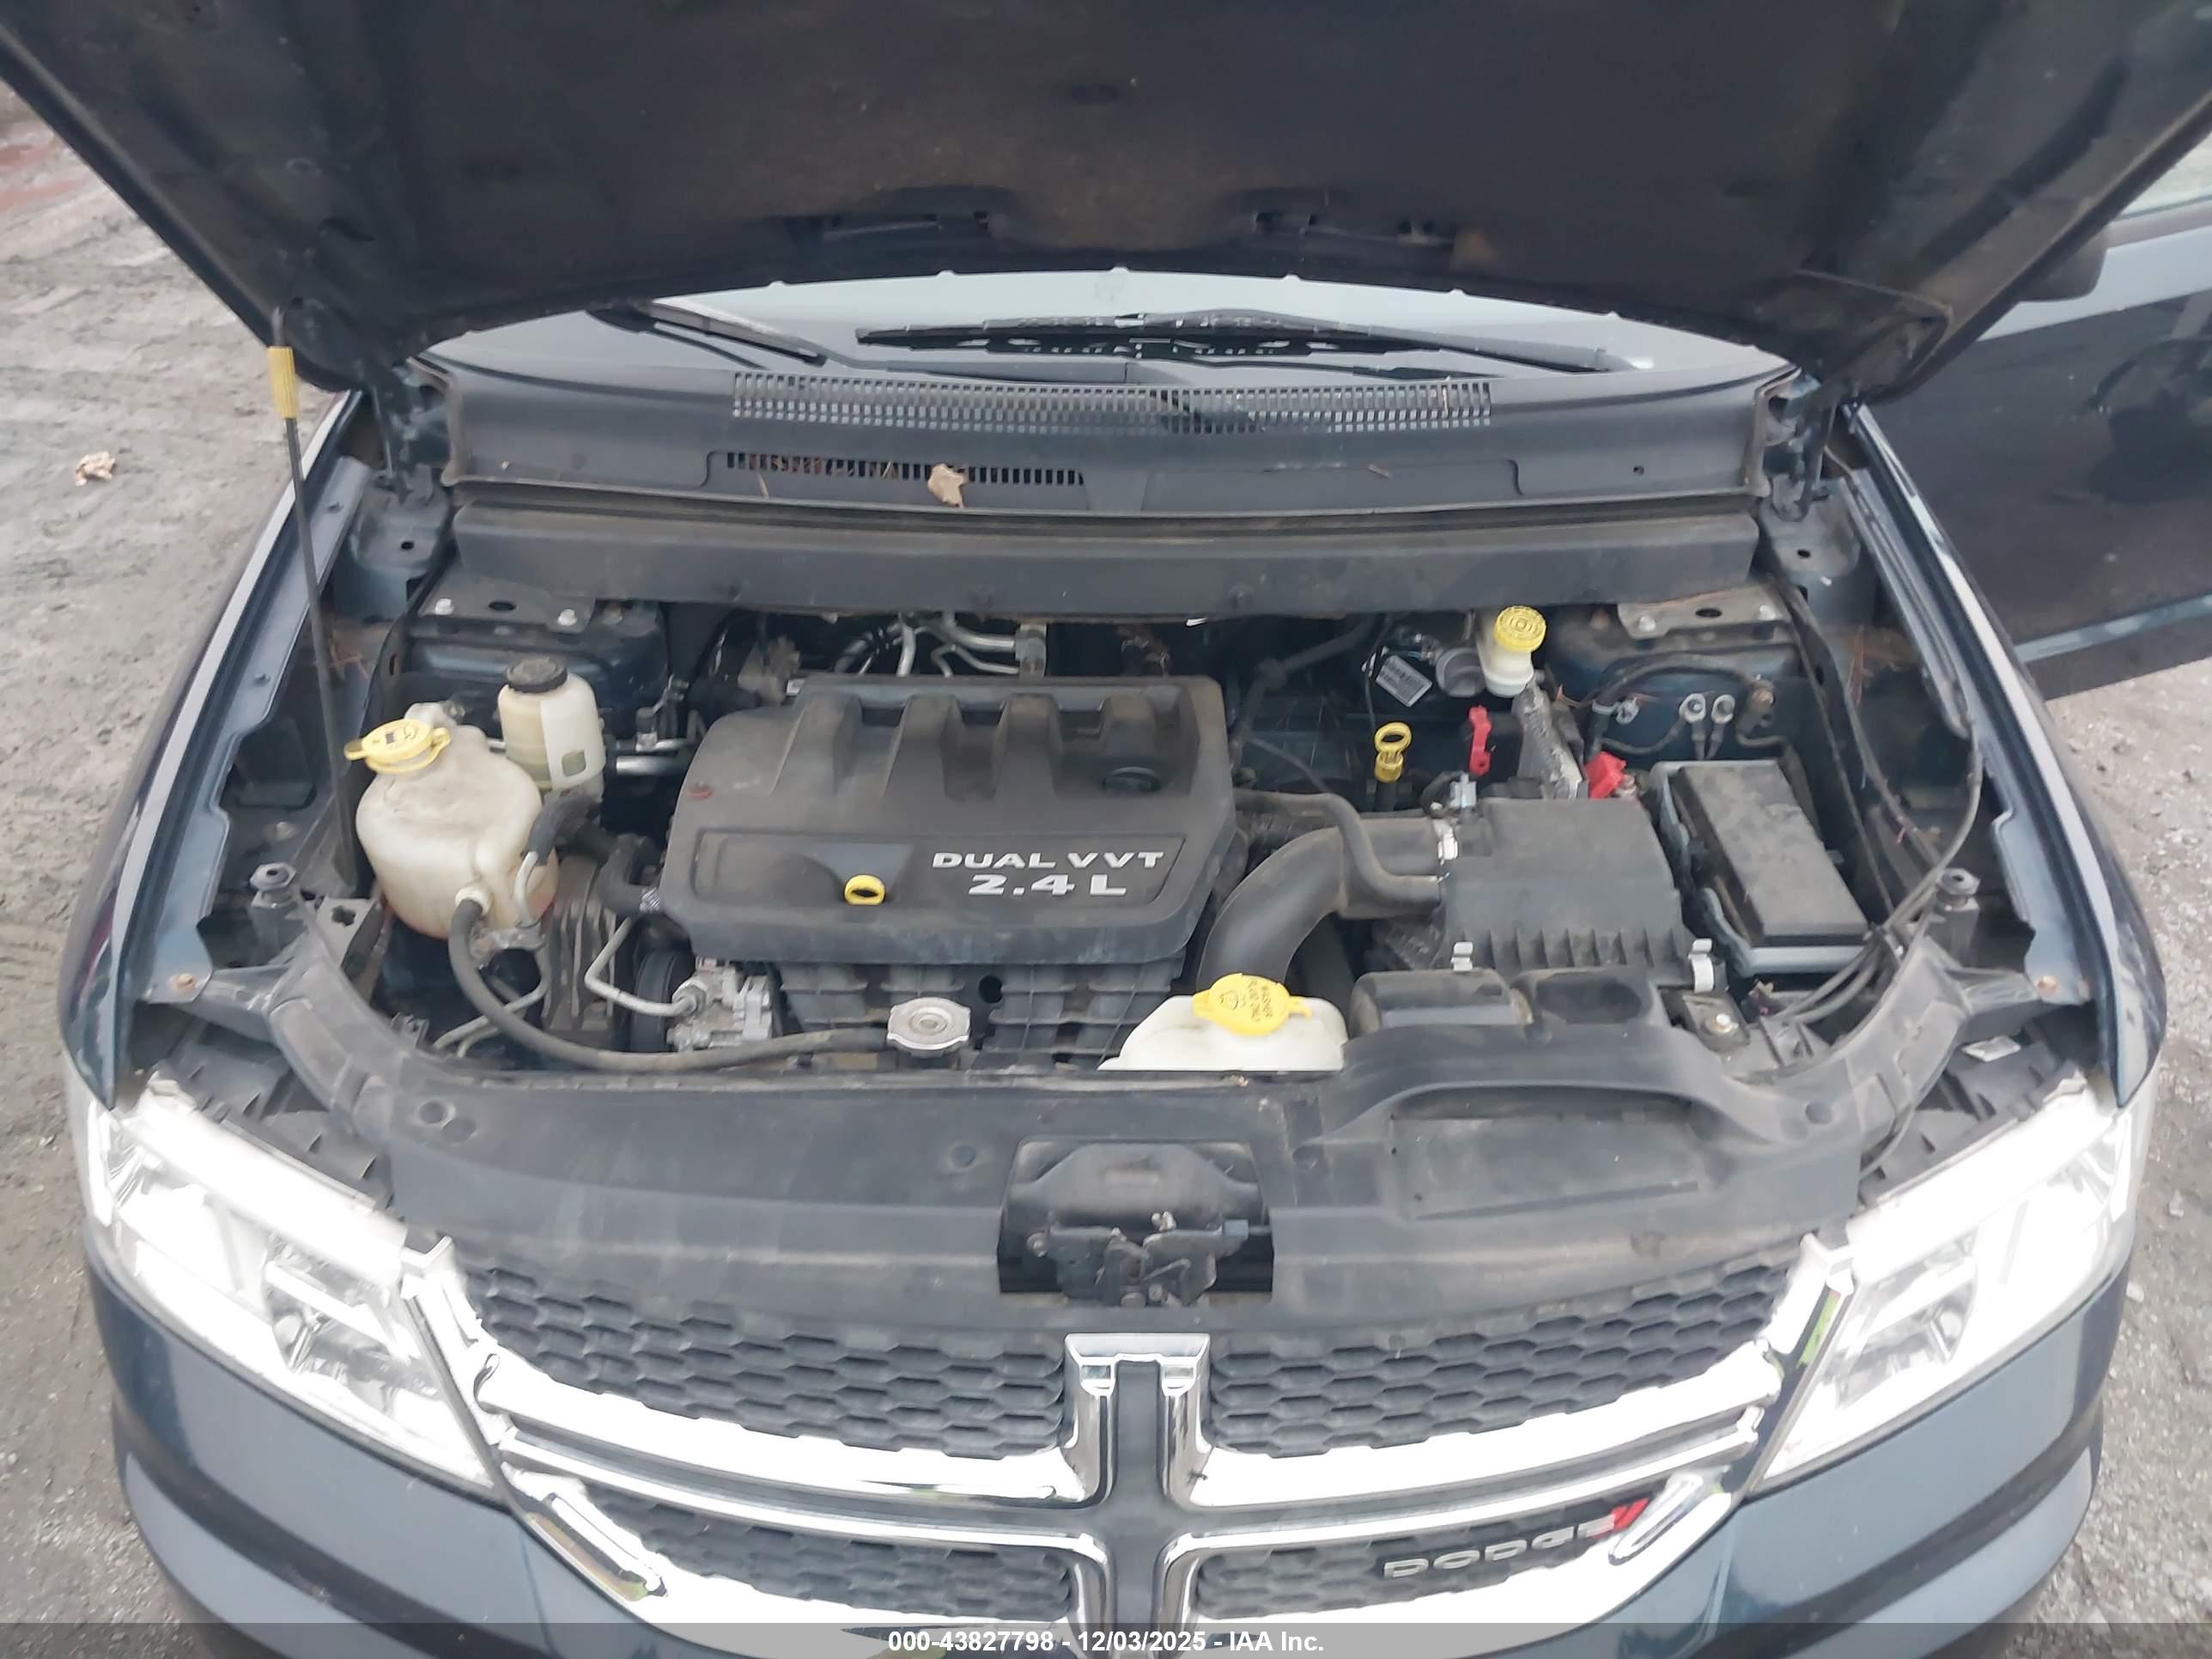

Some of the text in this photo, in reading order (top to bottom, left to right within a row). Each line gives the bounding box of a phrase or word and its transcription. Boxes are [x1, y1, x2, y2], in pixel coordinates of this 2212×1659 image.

[933, 851, 1164, 869] DUAL VVT
[968, 873, 1127, 896] 2.4 L
[1383, 1514, 1614, 1578] DODGE
